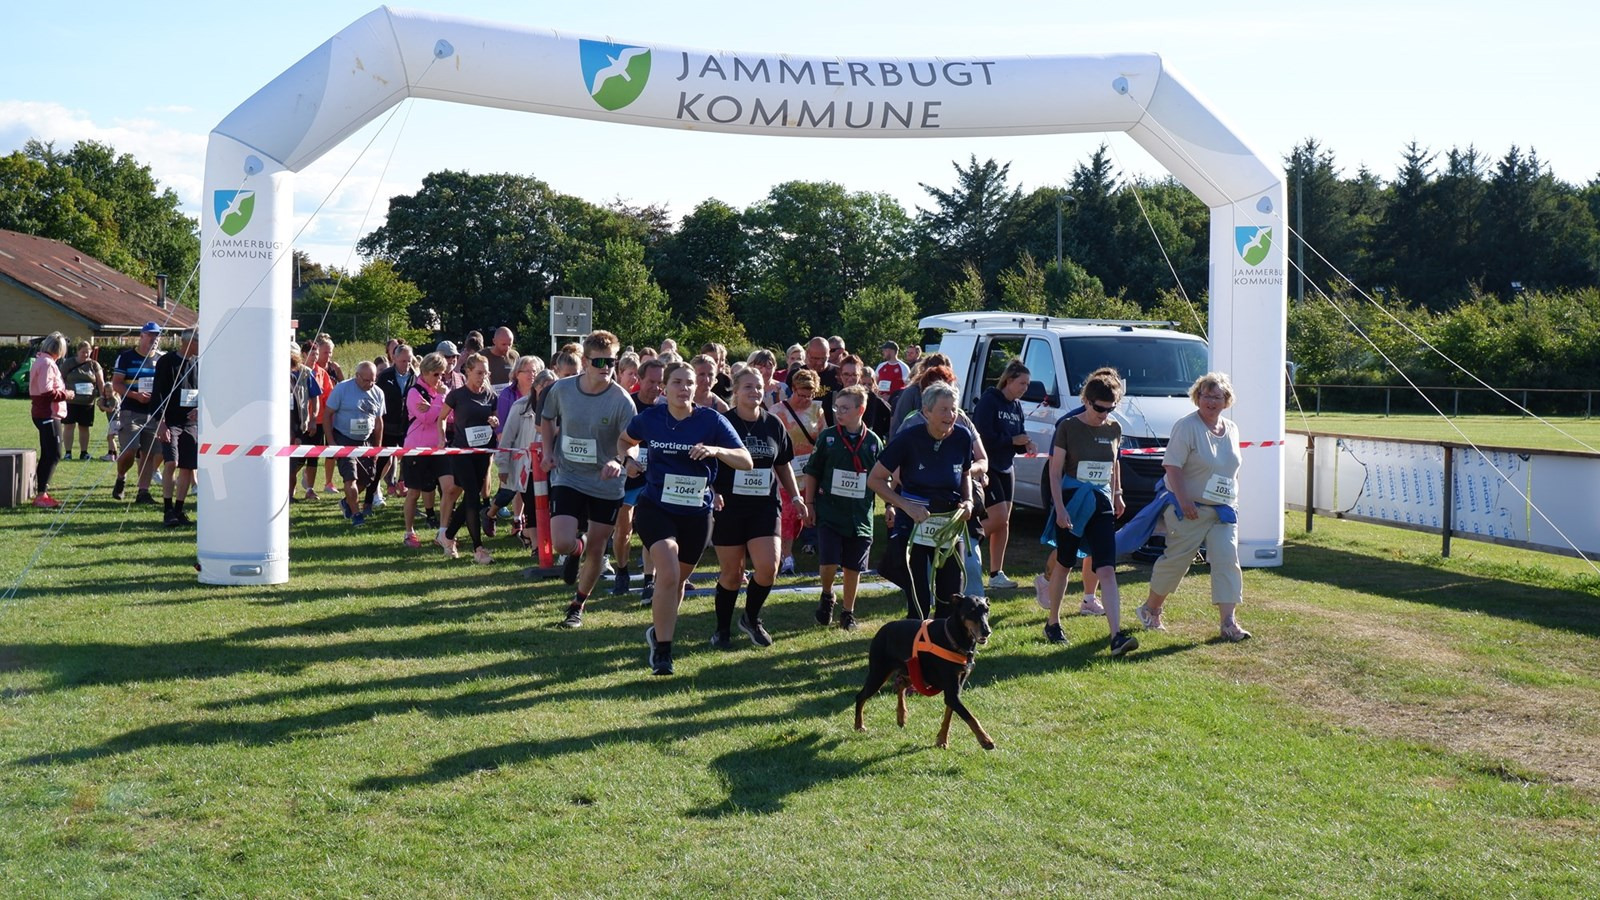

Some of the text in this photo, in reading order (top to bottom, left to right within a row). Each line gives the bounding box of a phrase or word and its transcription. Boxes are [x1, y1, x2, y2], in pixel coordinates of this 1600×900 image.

[677, 51, 995, 87] JAMMERBUGT
[677, 91, 942, 128] KOMMUNE
[212, 250, 273, 260] KOMMUNE
[1234, 277, 1283, 285] KOMMUNE
[474, 432, 487, 440] 1001
[570, 446, 588, 454] 1076
[1088, 471, 1103, 479] 977
[744, 478, 763, 486] 1046
[841, 480, 858, 489] 1071
[674, 485, 695, 495] 1044
[1215, 485, 1231, 496] 1035
